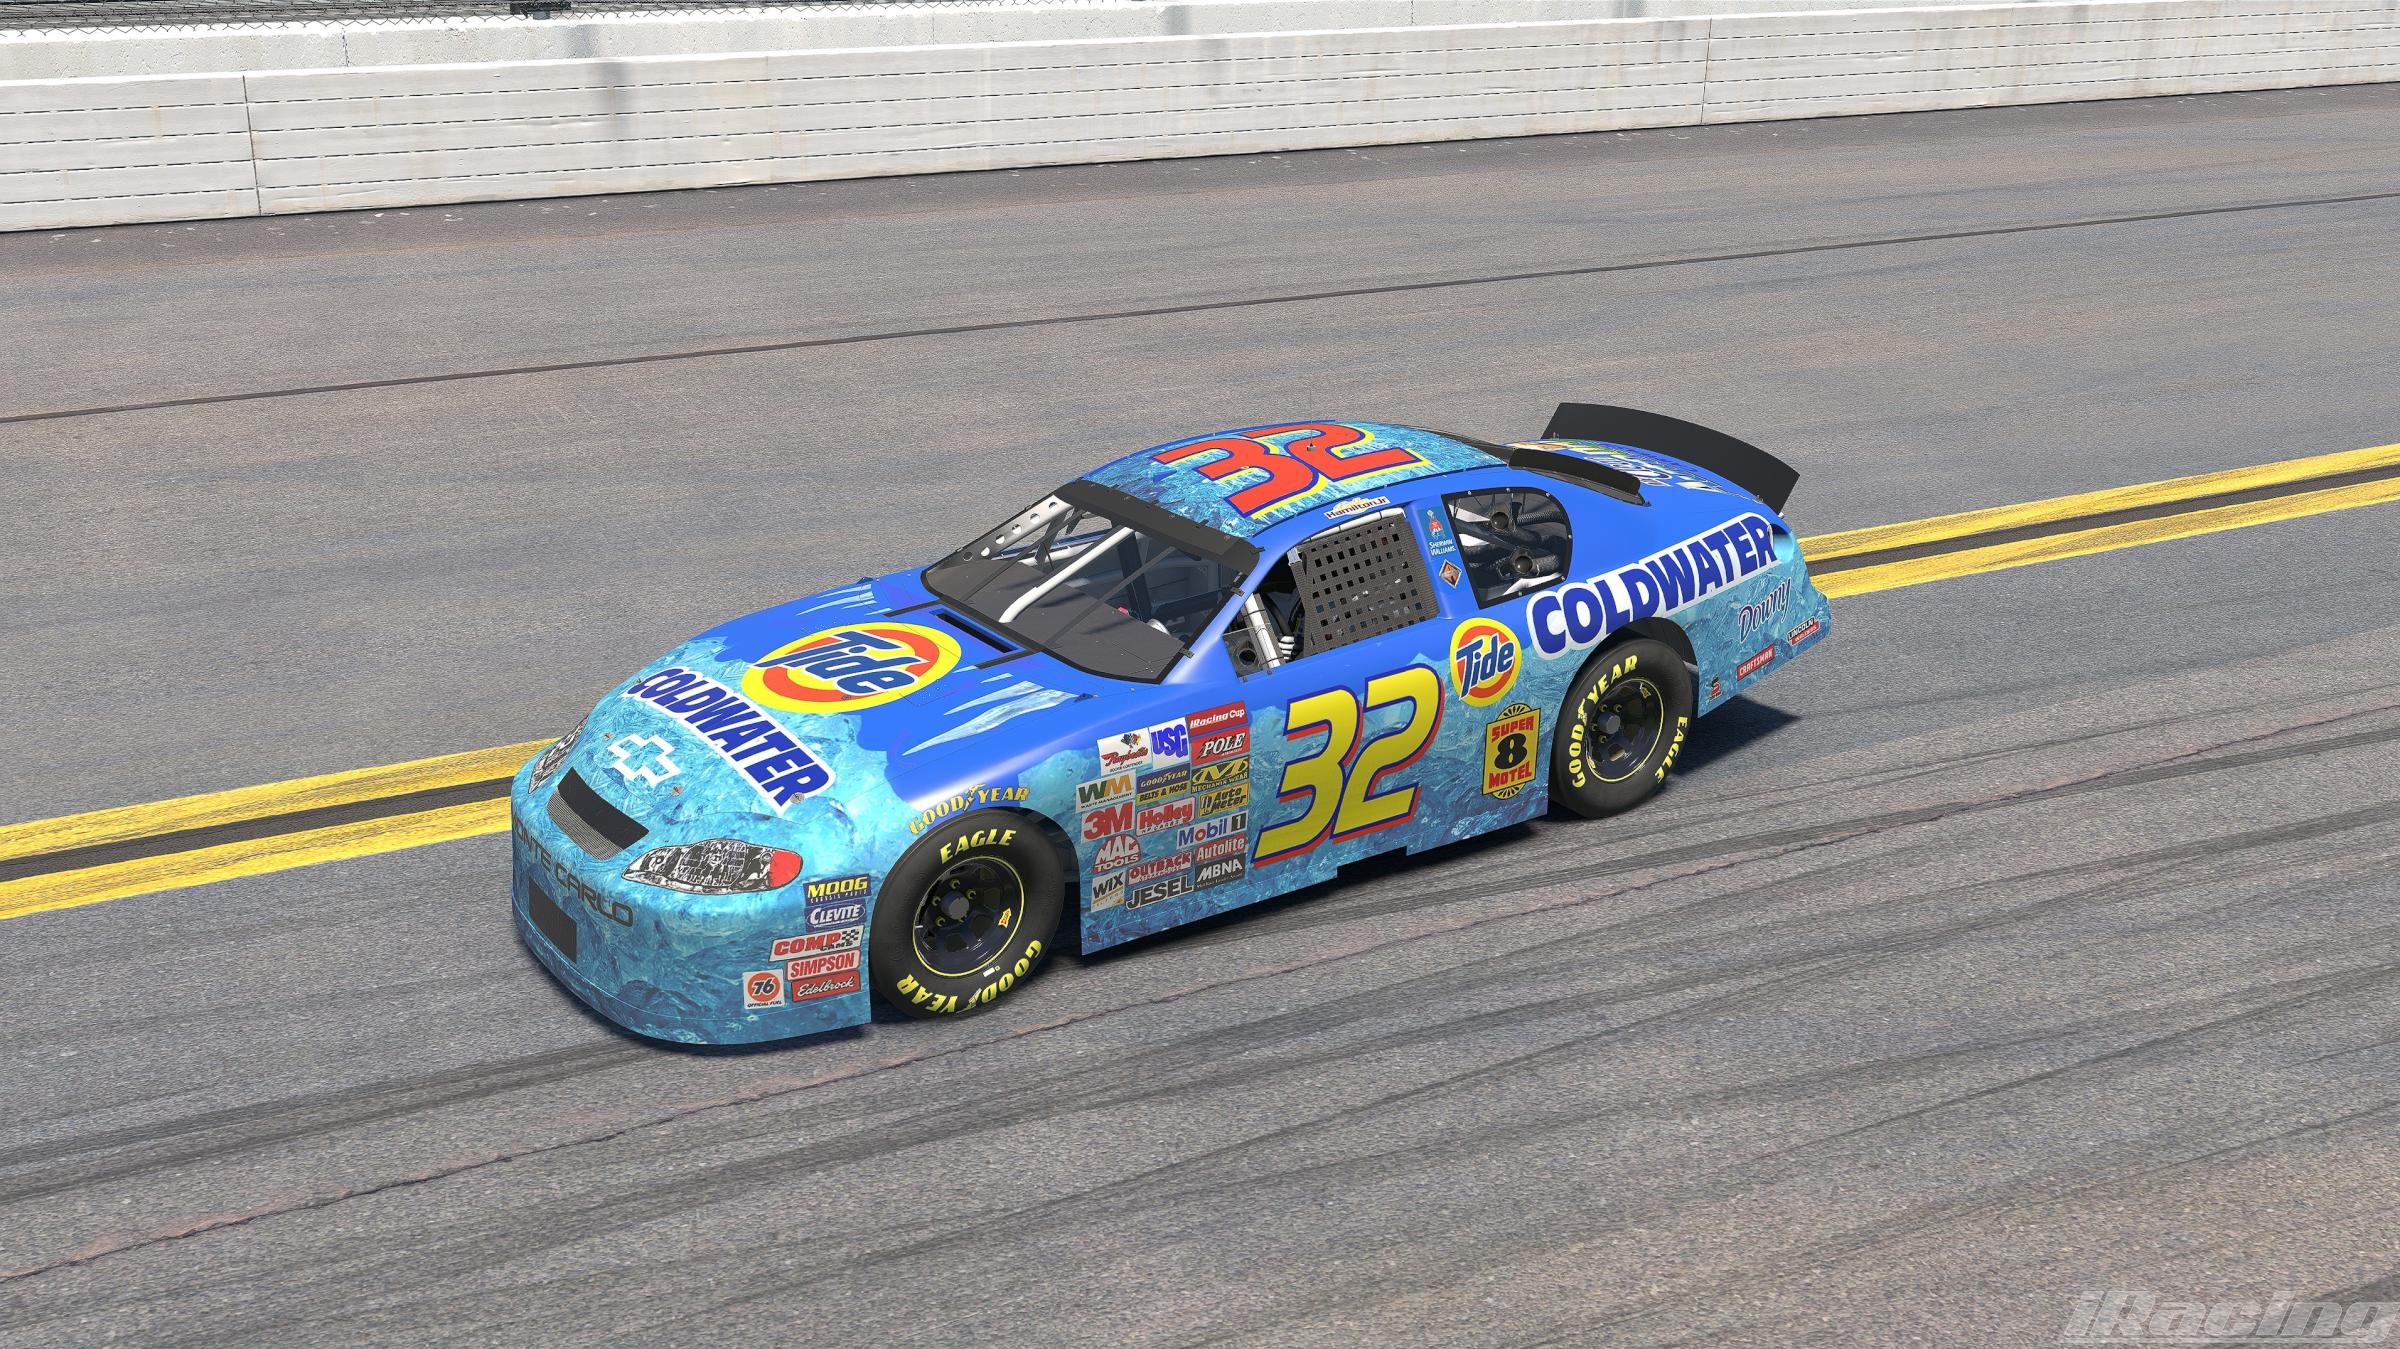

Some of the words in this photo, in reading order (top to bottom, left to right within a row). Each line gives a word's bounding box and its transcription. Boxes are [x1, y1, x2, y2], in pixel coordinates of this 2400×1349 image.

[1153, 422, 1431, 519] 32
[1532, 514, 1778, 655] COLDWATER
[1738, 577, 1791, 644] Downy
[1788, 617, 1814, 640] LINCOLN
[753, 630, 929, 697] Tide
[1456, 633, 1515, 700] Tide
[1739, 648, 1773, 676] CRAFTSMAN
[1229, 708, 1246, 719] Cup
[627, 668, 829, 807] COLDWATER
[1151, 724, 1189, 758] USG
[1491, 716, 1535, 742] SUPER
[1200, 732, 1246, 758] POLE
[1494, 733, 1527, 769] 8
[1655, 716, 1688, 783] EAGLE
[1252, 663, 1445, 867] 32
[1488, 761, 1532, 788] MOTEL
[1078, 774, 1132, 803] WM
[1139, 789, 1159, 801] BELTS
[1161, 788, 1167, 796] &
[1169, 783, 1188, 793] HOSE
[1192, 779, 1226, 793] MECHANIX
[1228, 771, 1248, 783] WEAR
[1083, 802, 1133, 840] 3M
[1139, 803, 1193, 829] Holley
[940, 828, 1016, 864] EAGLE
[1178, 818, 1228, 847] Mobil
[1095, 835, 1139, 865] MAC
[1095, 854, 1139, 872] TOOLS
[1196, 838, 1245, 861] Autolite
[1129, 851, 1191, 879] OUTBACK
[1196, 859, 1243, 882] MBNA
[555, 862, 634, 928] CARLO
[807, 877, 868, 898] MOOG
[1093, 872, 1123, 899] WIX
[1126, 876, 1194, 910] JESEL
[810, 904, 860, 925] CLEVITE
[774, 932, 841, 956] COMP
[790, 952, 855, 978] SIMPSON
[752, 977, 776, 996] 76
[798, 976, 855, 997] Edelbrock
